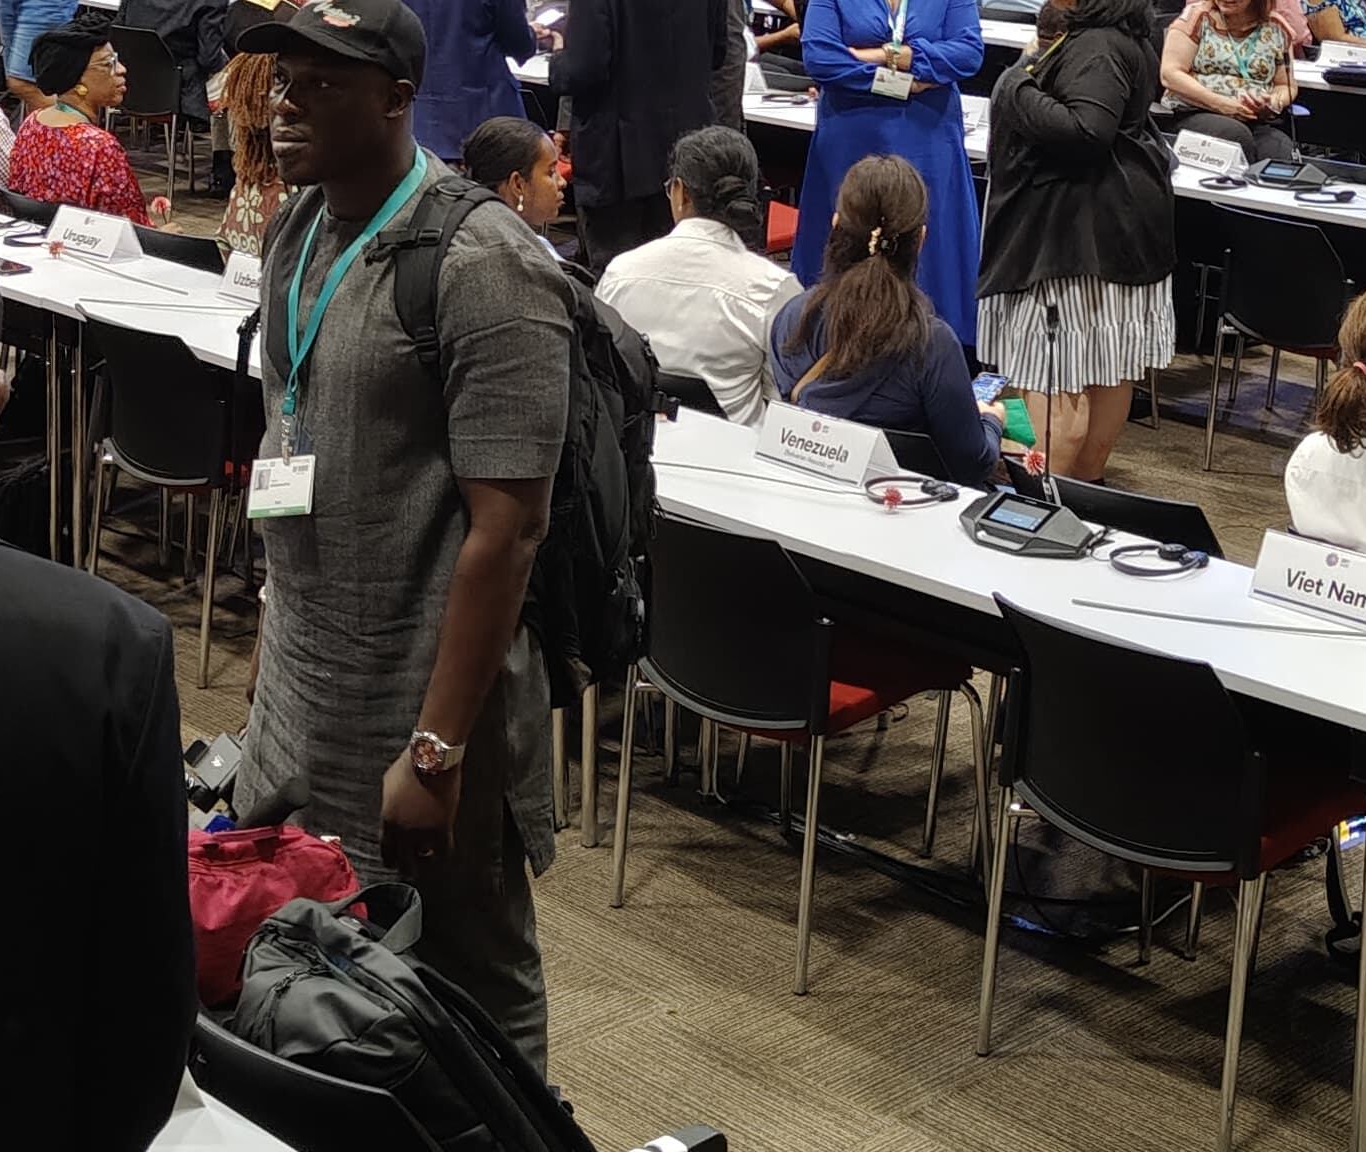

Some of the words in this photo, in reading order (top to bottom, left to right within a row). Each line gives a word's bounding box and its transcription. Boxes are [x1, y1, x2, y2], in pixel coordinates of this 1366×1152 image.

[63, 228, 102, 248] Uruguay
[780, 427, 849, 464] Venezuela
[1286, 568, 1323, 596] Viet
